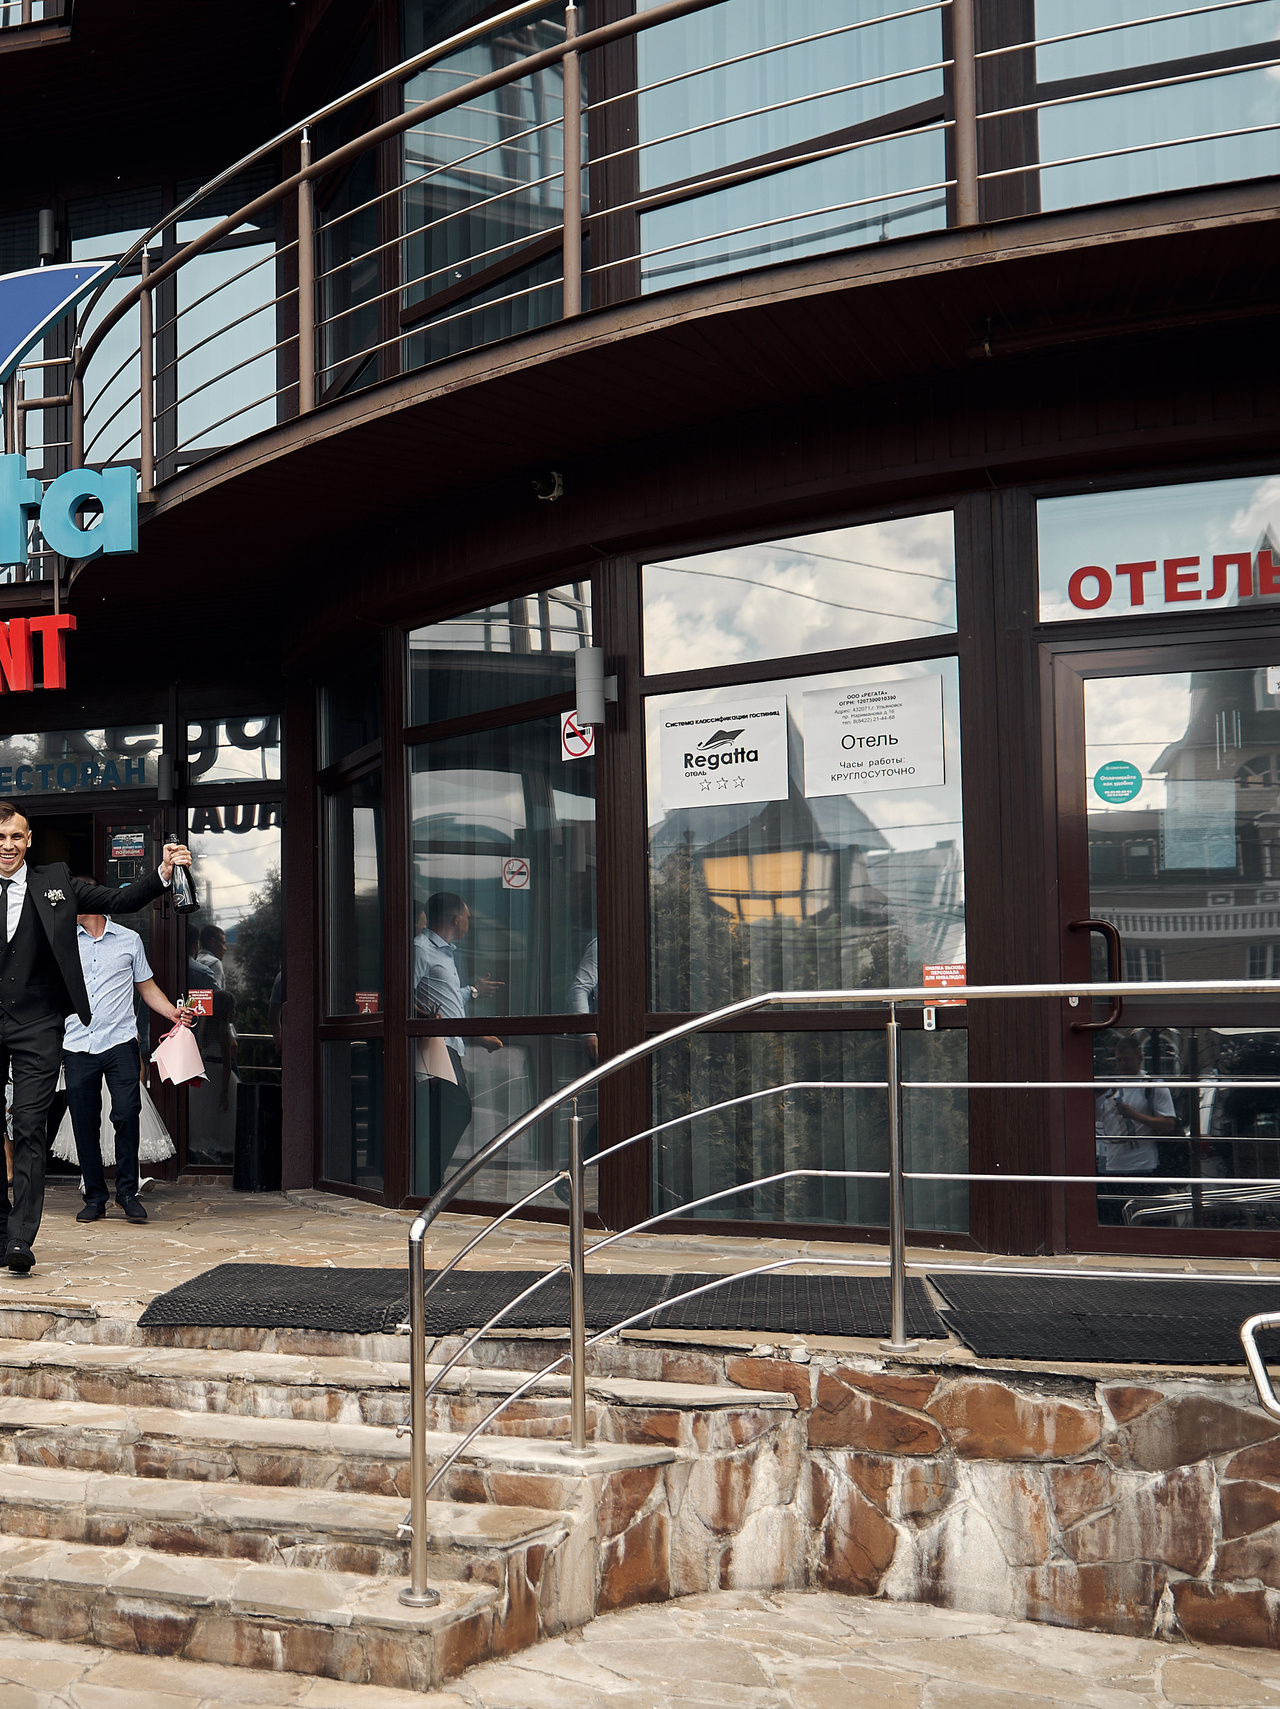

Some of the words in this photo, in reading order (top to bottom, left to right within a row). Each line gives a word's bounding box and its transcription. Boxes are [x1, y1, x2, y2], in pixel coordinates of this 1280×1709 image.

[665, 718, 695, 728] Система
[695, 713, 749, 725] классификации
[749, 710, 780, 719] гостиниц
[841, 734, 899, 750] Отель
[683, 747, 759, 770] Regatta
[839, 761, 864, 769] Часы
[868, 756, 906, 767] работы:
[830, 766, 916, 782] КРУГЛОСУТОЧНО
